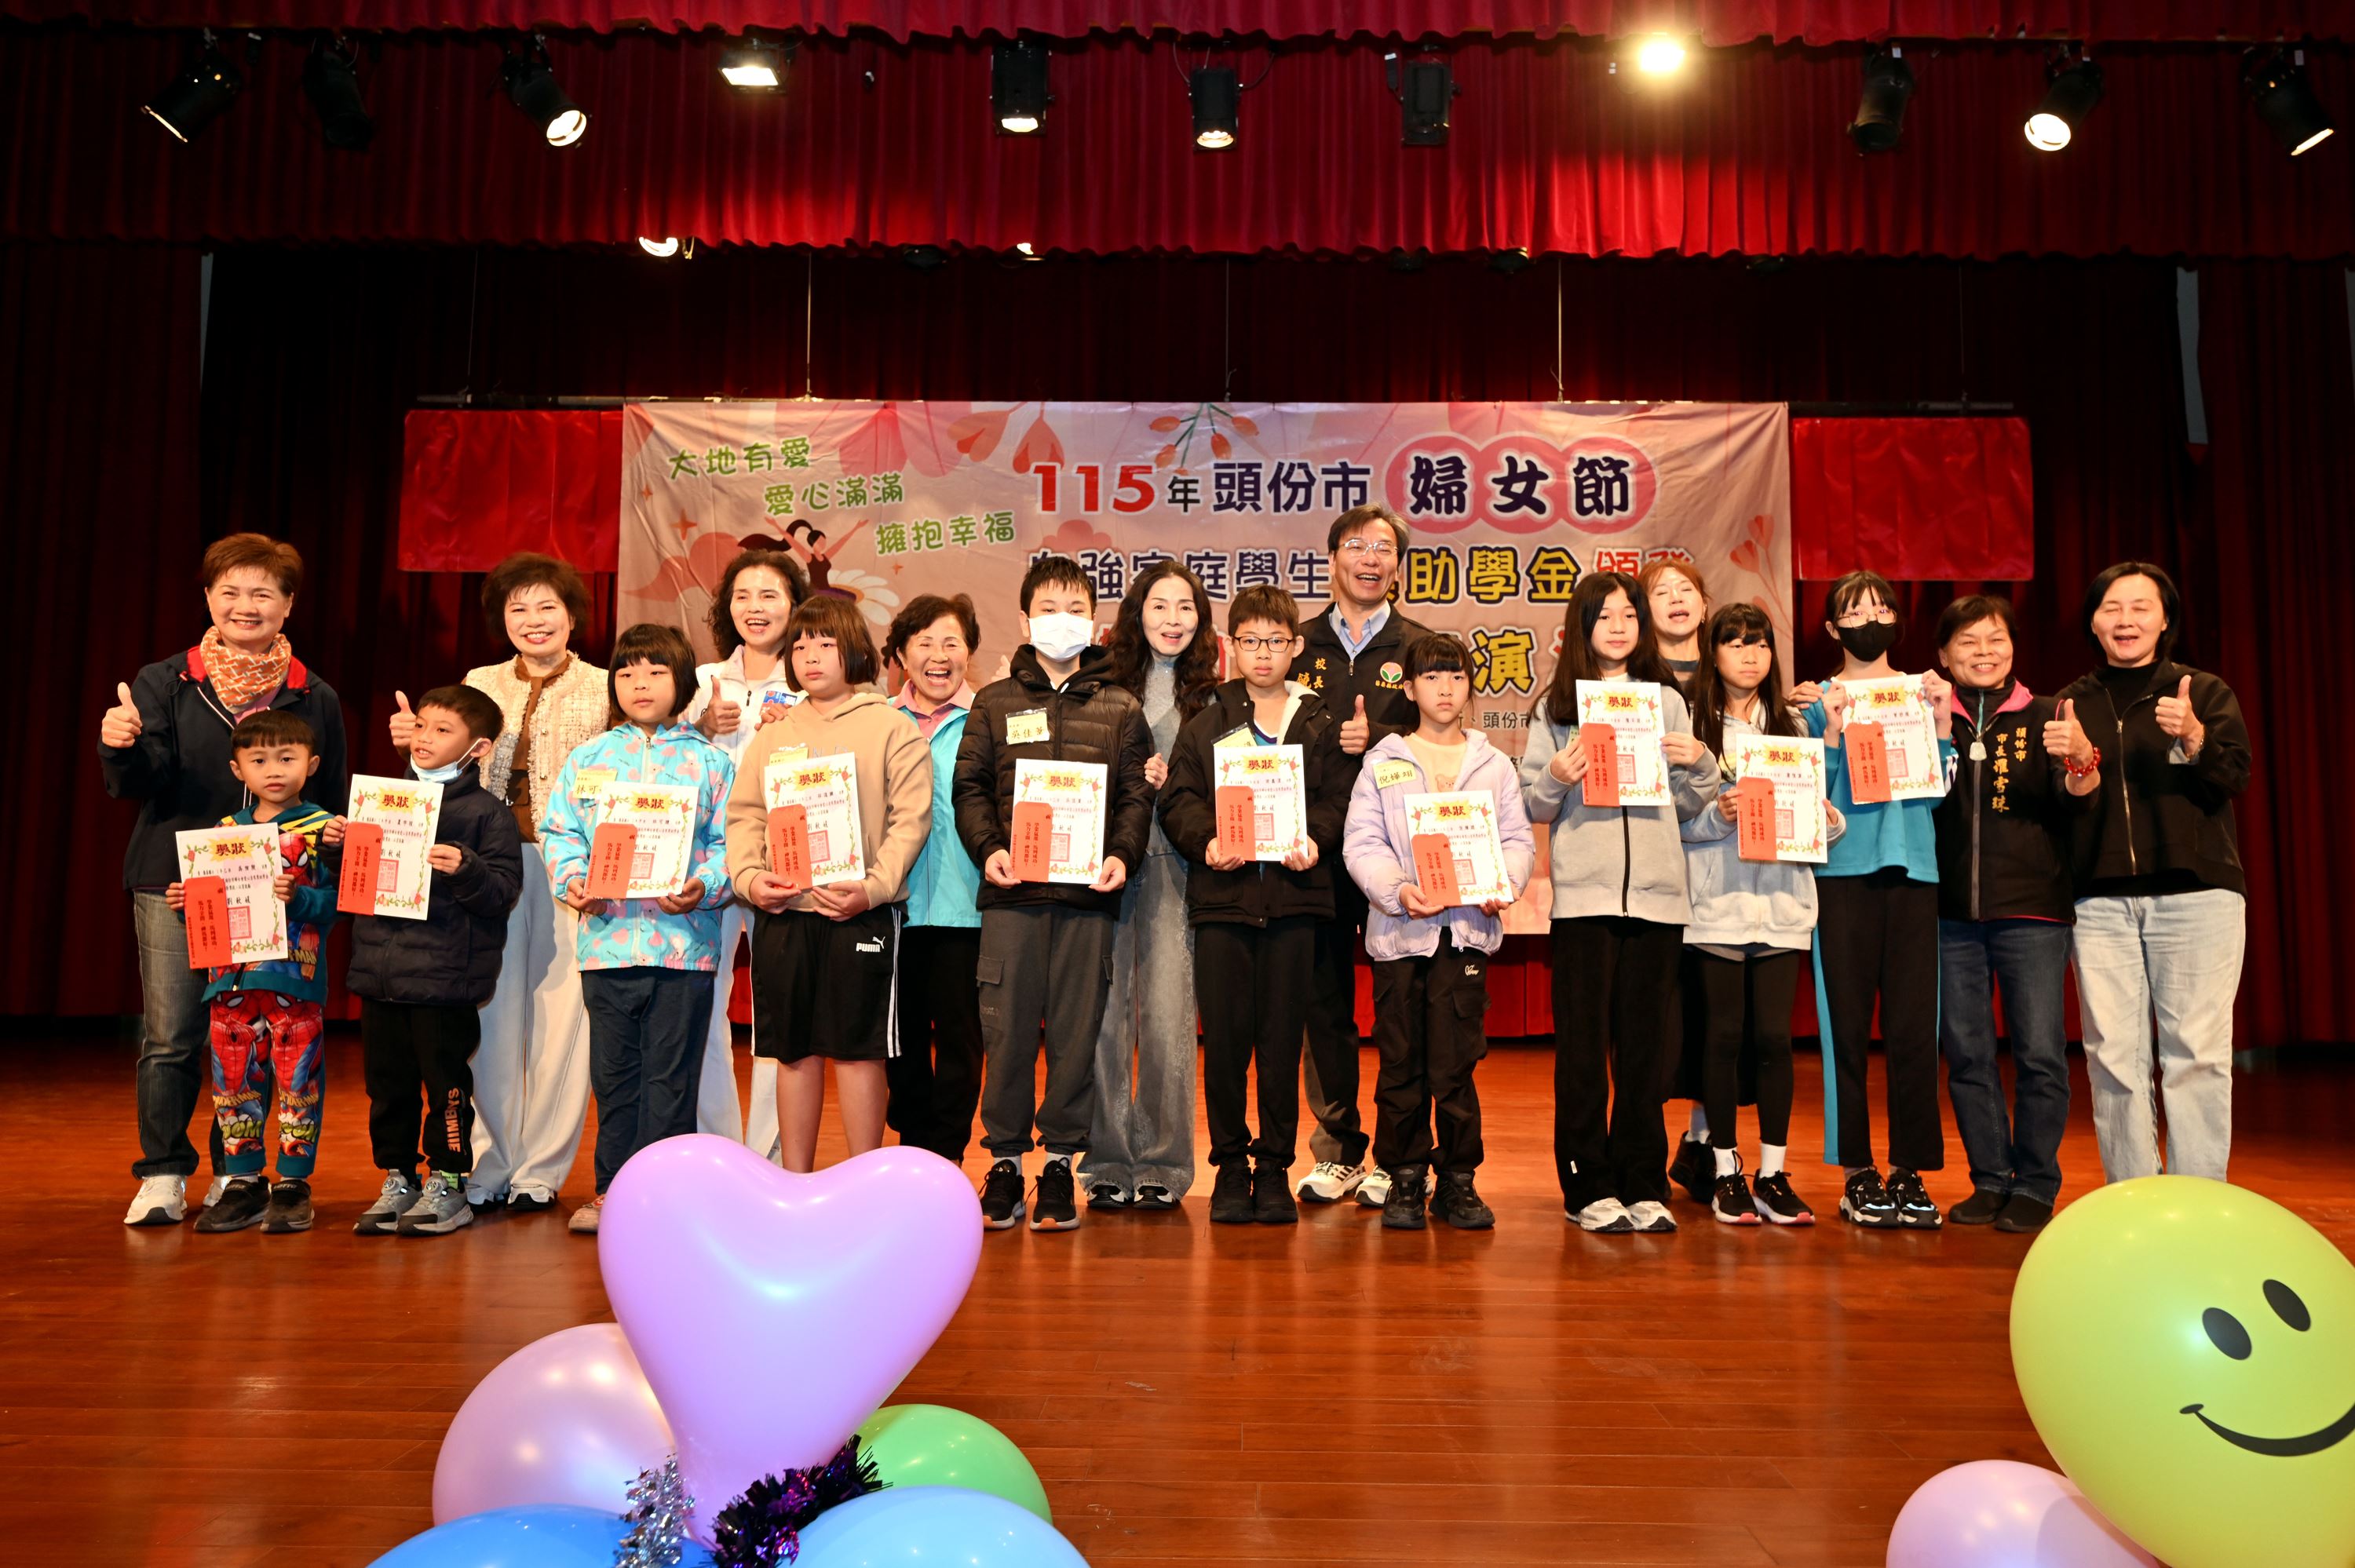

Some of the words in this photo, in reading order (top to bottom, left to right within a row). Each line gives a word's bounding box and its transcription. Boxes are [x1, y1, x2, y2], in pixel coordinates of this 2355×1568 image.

[668, 436, 811, 480] 大地有愛
[764, 472, 904, 516] 愛心滿滿
[876, 511, 1016, 555] 擁抱幸福
[856, 943, 881, 953] PUMA
